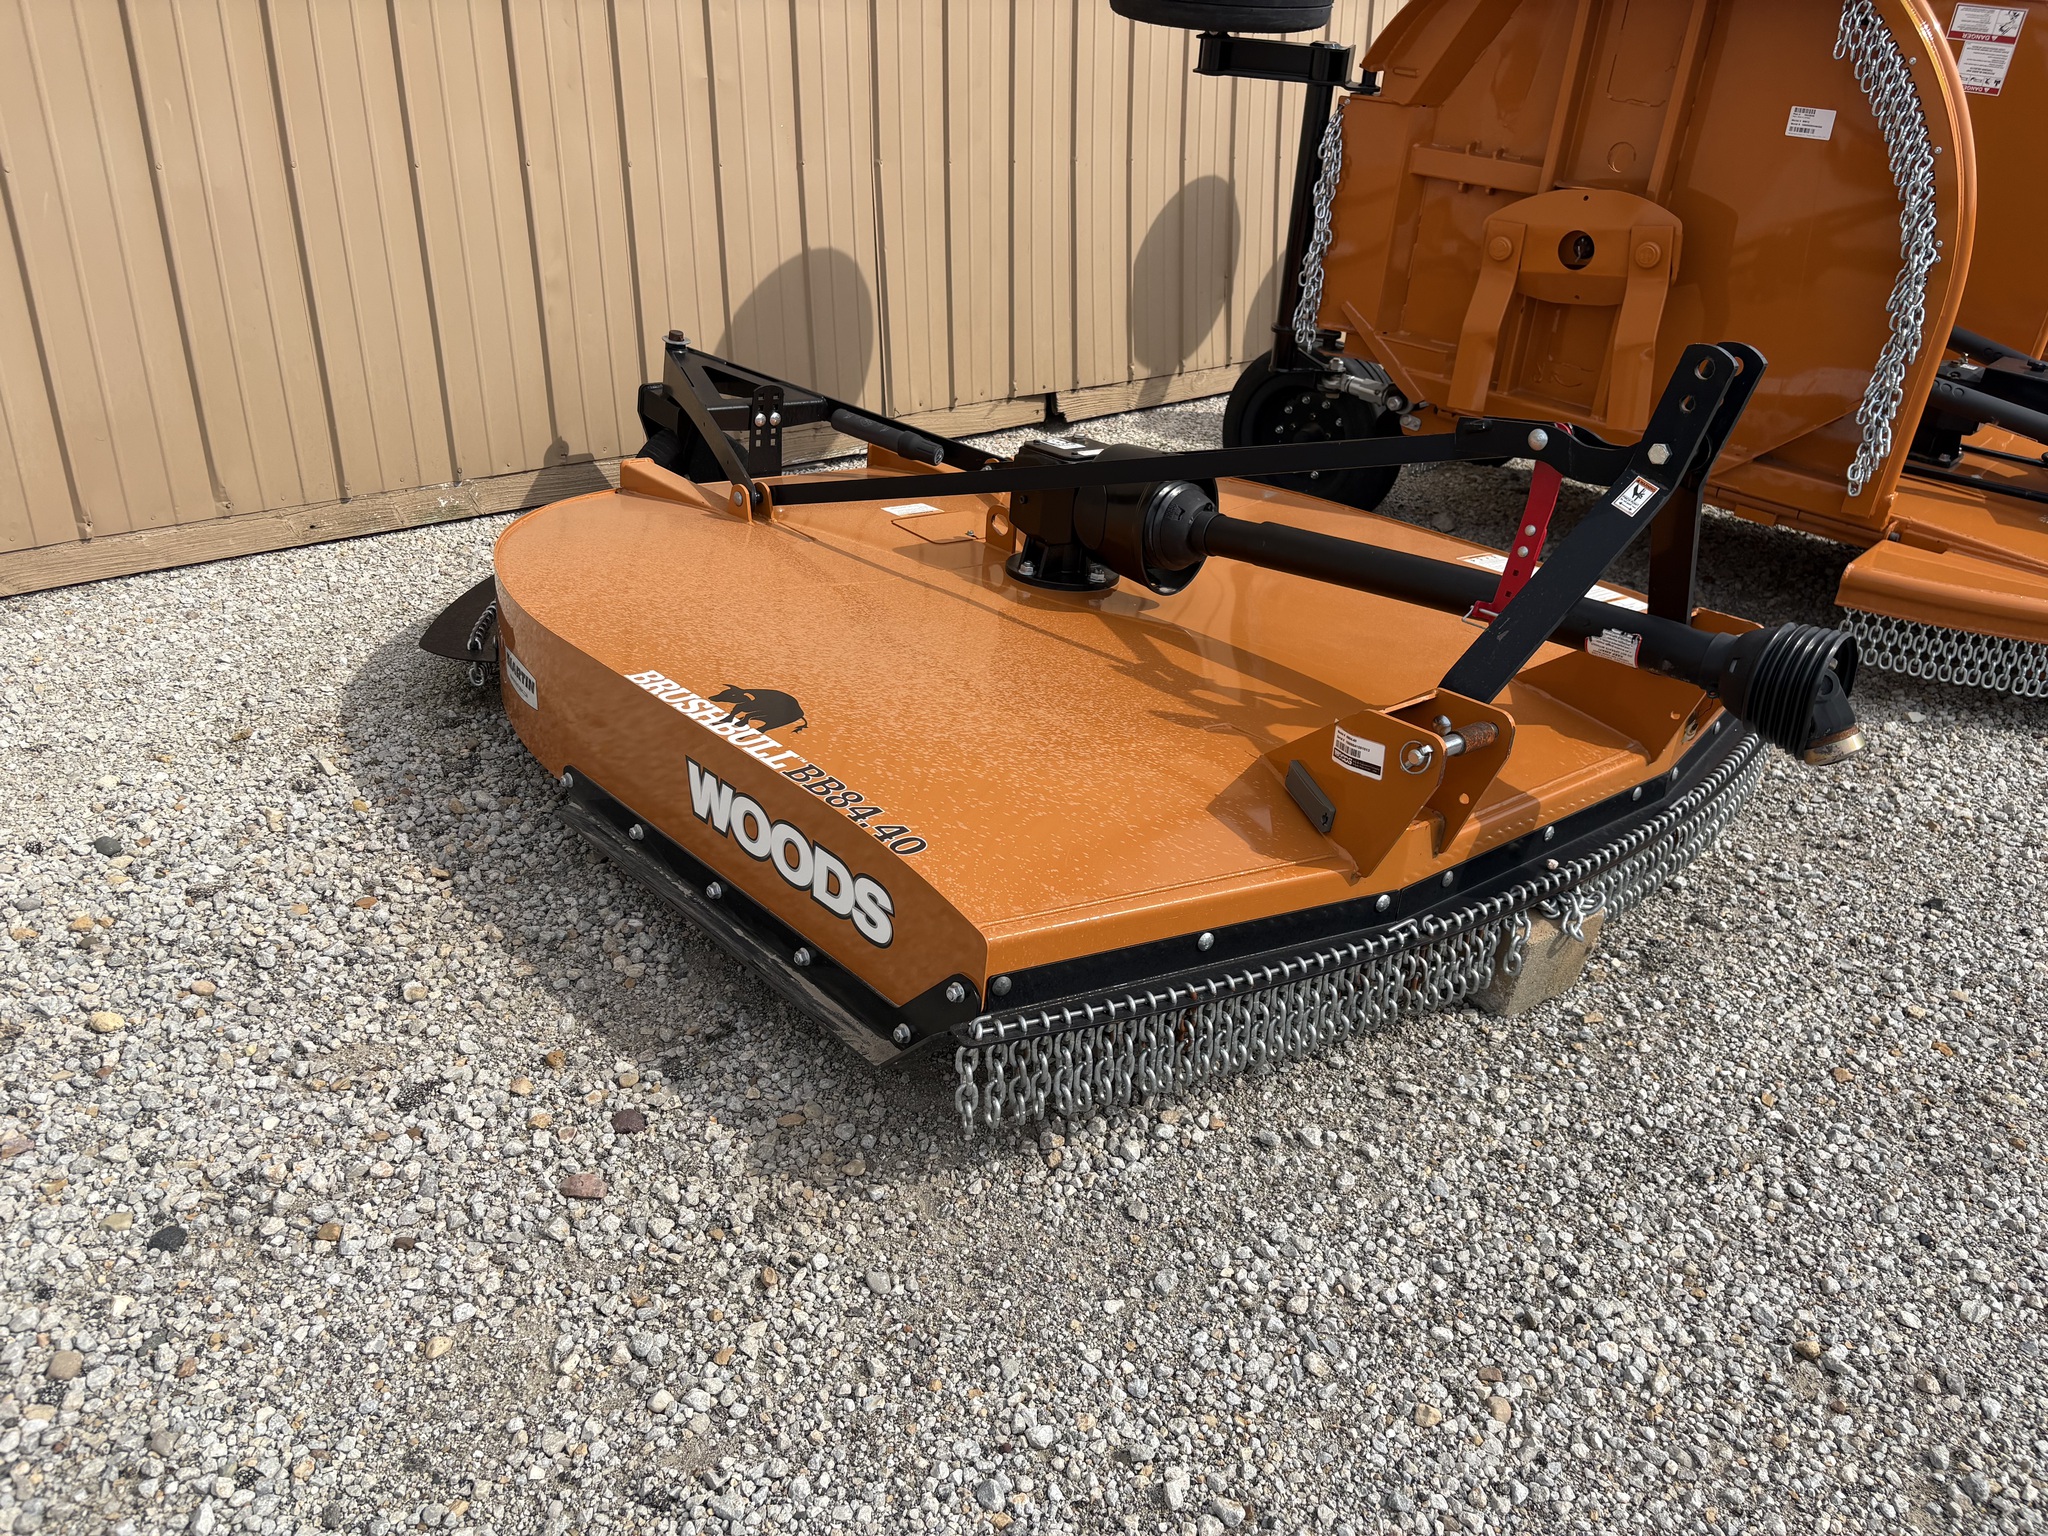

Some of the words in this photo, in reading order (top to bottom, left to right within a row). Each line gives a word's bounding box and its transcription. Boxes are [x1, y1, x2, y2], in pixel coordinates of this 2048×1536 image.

[1962, 32, 1991, 41] DANGER
[685, 754, 896, 949] WOODS
[780, 763, 928, 856] BB84.40
